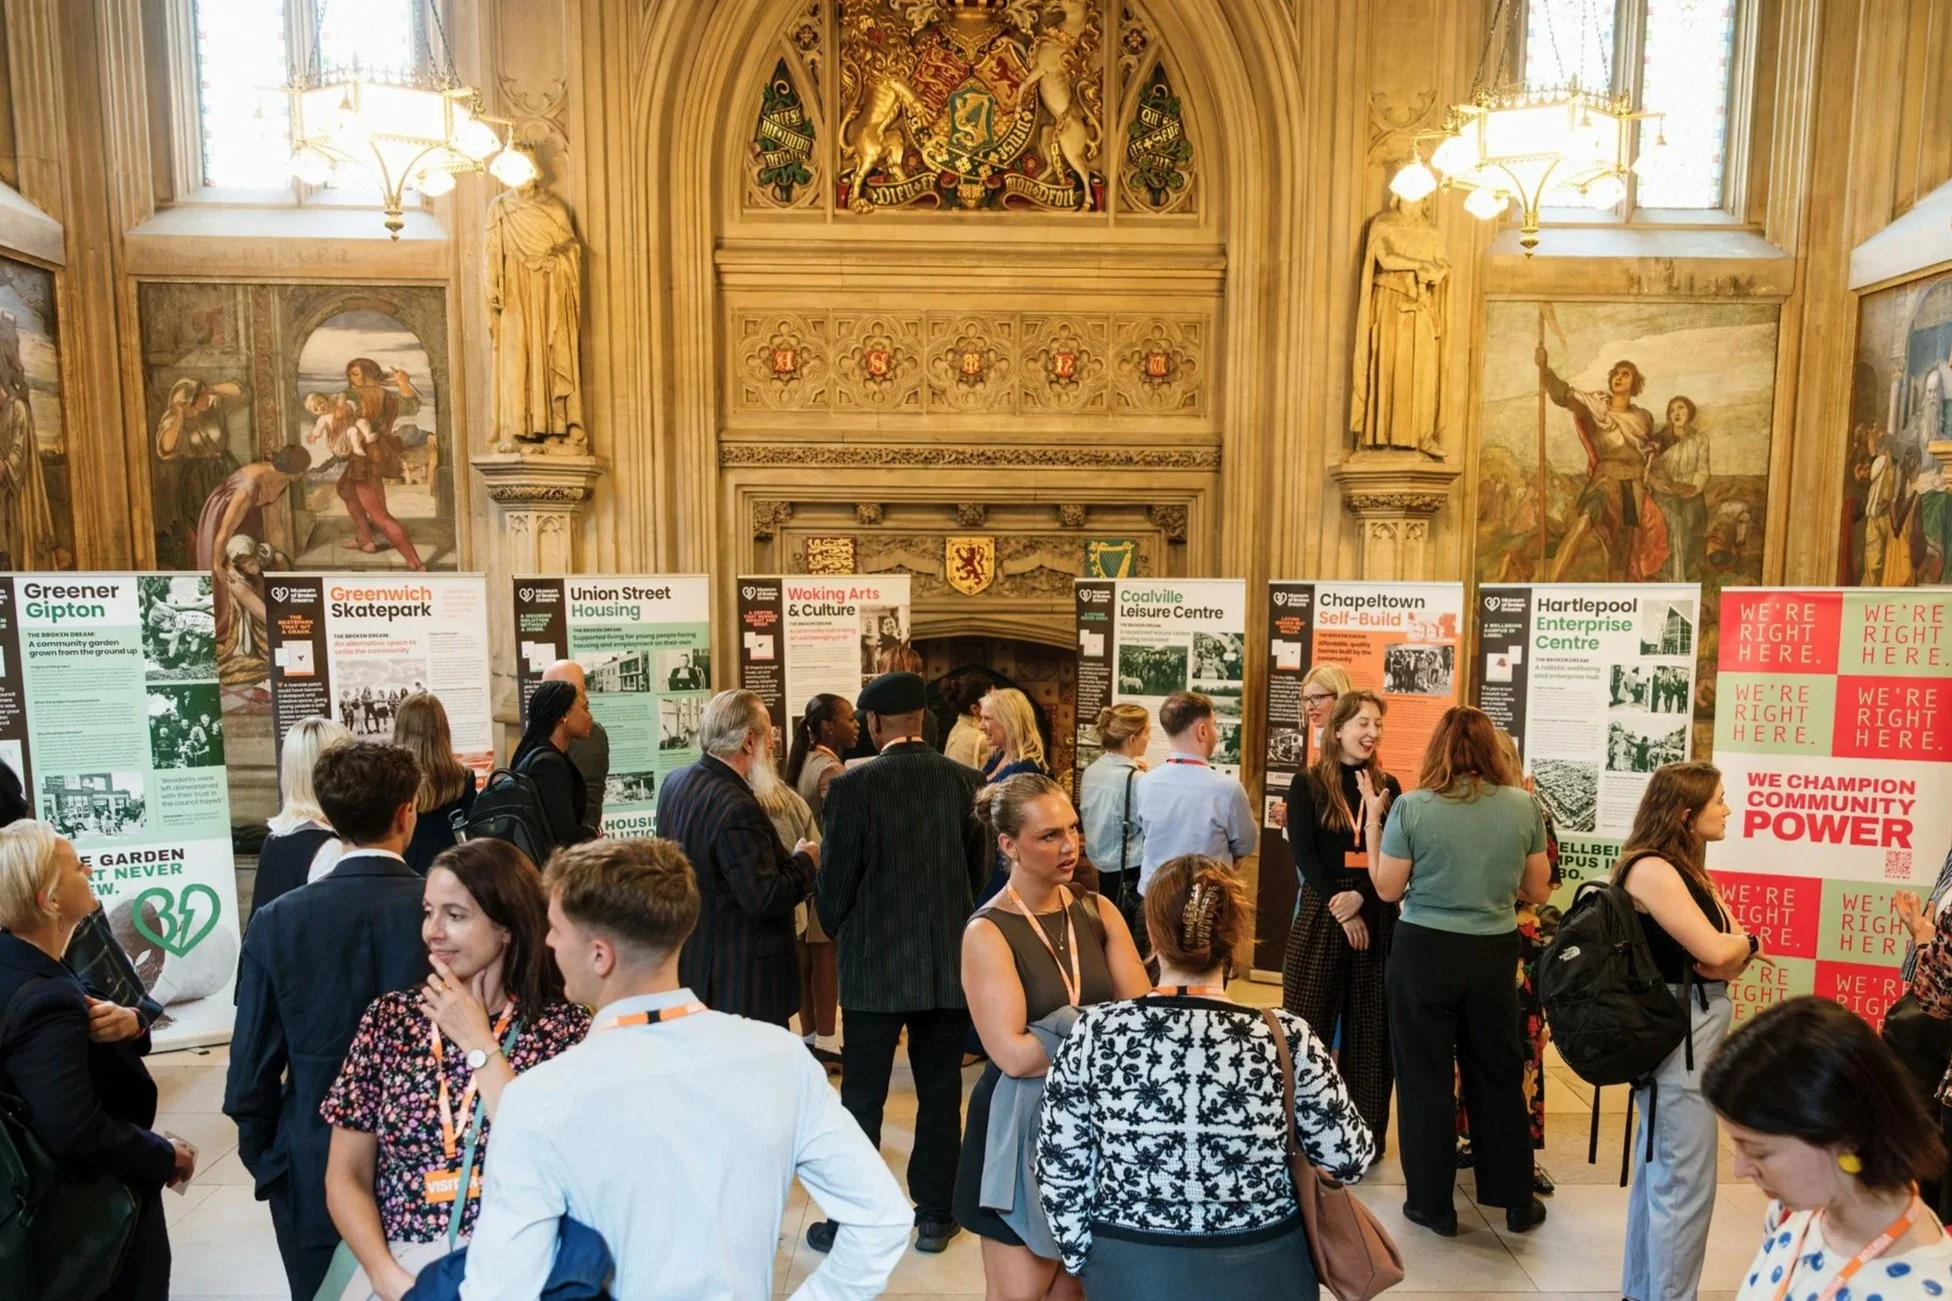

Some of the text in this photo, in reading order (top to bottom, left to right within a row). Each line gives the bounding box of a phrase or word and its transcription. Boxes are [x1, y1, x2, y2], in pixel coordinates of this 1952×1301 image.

[24, 583, 119, 599] Greener
[330, 585, 432, 601] Greenwich
[570, 586, 619, 601] Union
[622, 586, 671, 600] Street
[788, 586, 845, 604] Woking
[848, 588, 880, 600] Arts
[1120, 589, 1183, 603] Coalville
[26, 600, 105, 623] Gipton
[572, 602, 641, 621] Housing
[788, 603, 856, 617] & Culture
[1320, 593, 1425, 612] Chapeltown
[1538, 598, 1638, 617] Hartlepool
[331, 602, 432, 622] Skatepark
[1120, 604, 1171, 618] Leisure
[1174, 606, 1224, 620] Centre
[1320, 611, 1402, 627] Self-Build
[1740, 603, 1816, 622] WE'RE
[1864, 604, 1945, 623] WE'RE
[1536, 616, 1632, 636] Enterprise
[1740, 624, 1816, 643] RIGHT
[1864, 626, 1944, 644] RIGHT
[36, 640, 87, 649] community
[88, 639, 119, 649] garden
[386, 640, 408, 648] space
[573, 634, 606, 642] Supported
[635, 633, 654, 641] young
[656, 632, 676, 640] people
[613, 641, 654, 650] employment
[1350, 641, 1370, 649] quality
[1536, 635, 1600, 650] Centre
[30, 650, 57, 658] grown
[58, 648, 79, 656] from
[95, 647, 125, 657] ground
[126, 648, 138, 656] up
[367, 648, 410, 656] community
[1318, 655, 1352, 664] community
[1352, 648, 1360, 656] by
[1738, 644, 1822, 664] HERE.
[1862, 646, 1950, 666] HERE.
[1567, 664, 1600, 674] wellbeing
[1736, 684, 1810, 703] WE'RE
[1858, 687, 1938, 708] WE'RE
[1734, 704, 1810, 723] RIGHT
[1857, 708, 1937, 728] RIGHT
[1733, 724, 1815, 745] HERE.
[1855, 729, 1944, 751] HERE.
[160, 784, 173, 792] left
[1747, 772, 1916, 795] WE CHAMPION
[162, 792, 176, 800] with
[1747, 790, 1916, 816] COMMUNITY
[605, 816, 657, 831] HOUSI
[1743, 809, 1914, 849] POWER
[100, 848, 185, 867] GARDEN
[1559, 842, 1619, 856] ELLBEI
[114, 863, 183, 880] NEVER
[1841, 913, 1903, 936] RIGH
[1840, 934, 1910, 956] HER
[1732, 985, 1788, 1004] IGHT
[425, 1176, 478, 1194] VISITR
